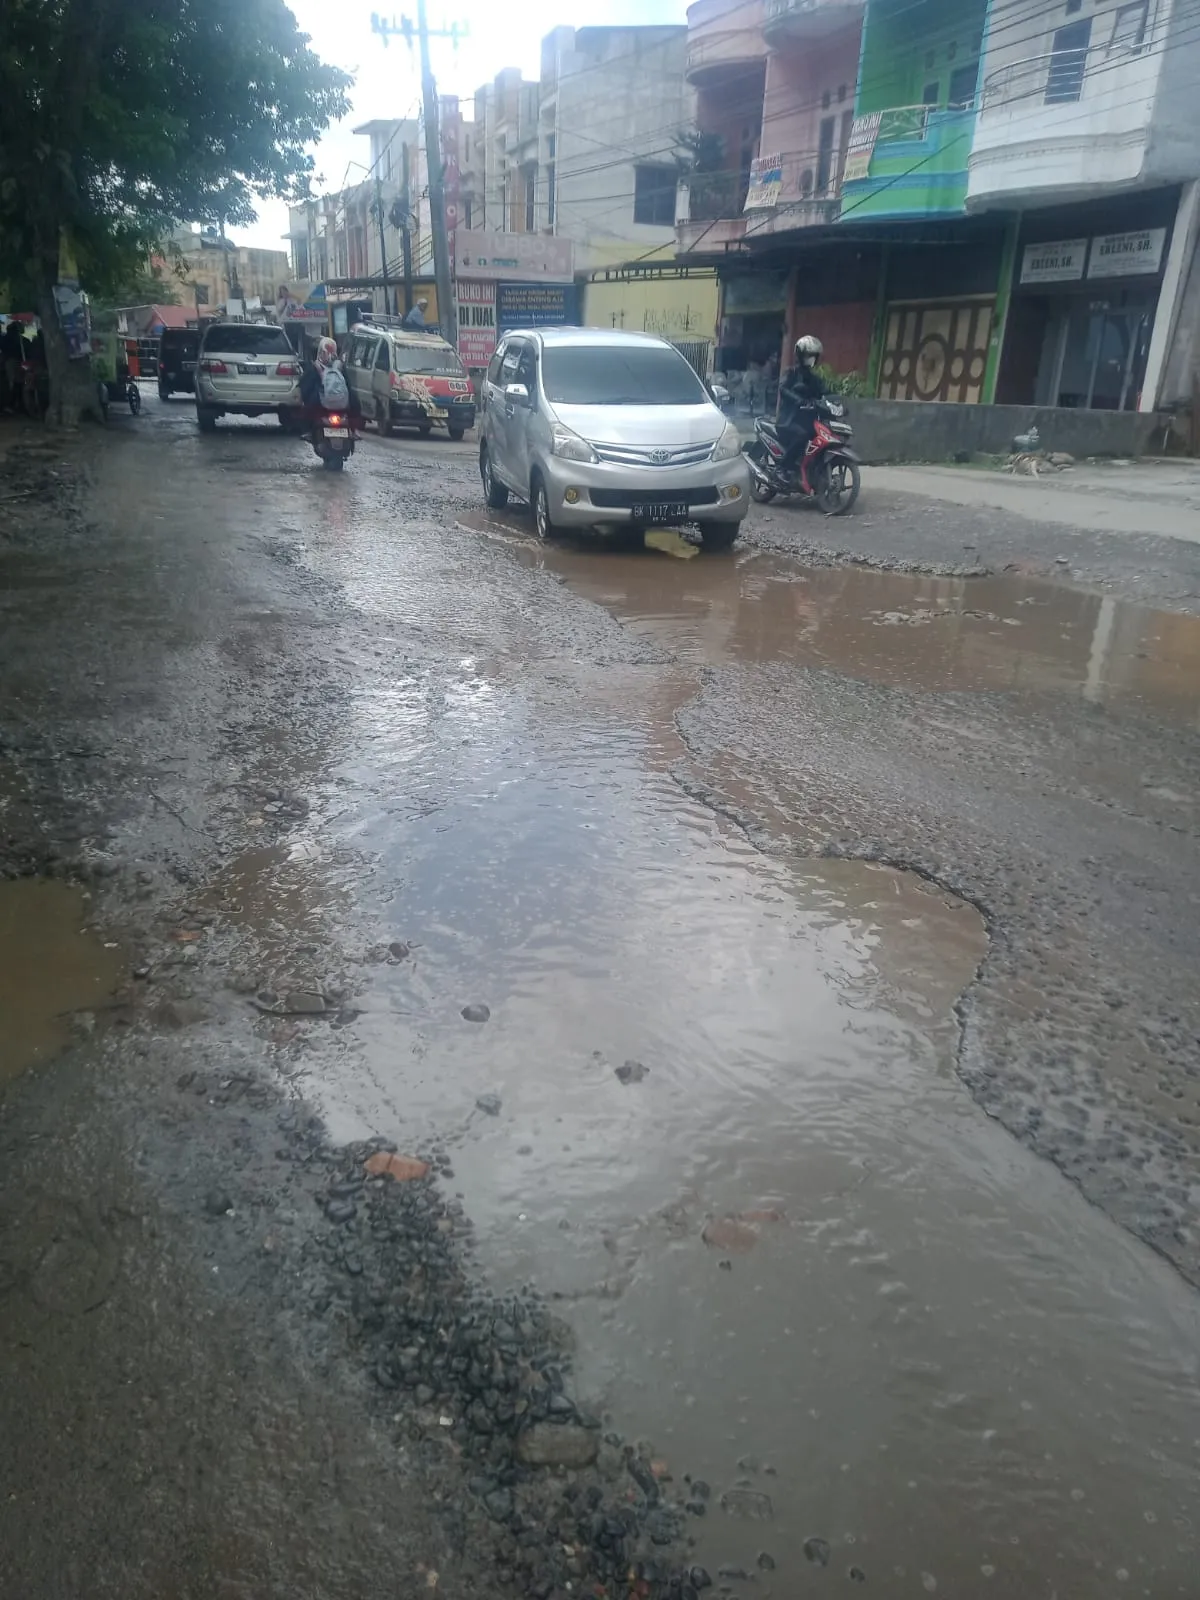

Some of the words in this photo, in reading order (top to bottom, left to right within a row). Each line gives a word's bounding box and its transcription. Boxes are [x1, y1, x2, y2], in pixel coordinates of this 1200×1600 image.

[459, 283, 480, 300] RUKO
[482, 283, 494, 301] INI
[459, 306, 470, 326] DI
[472, 306, 495, 327] JUAL
[649, 505, 668, 517] 1117
